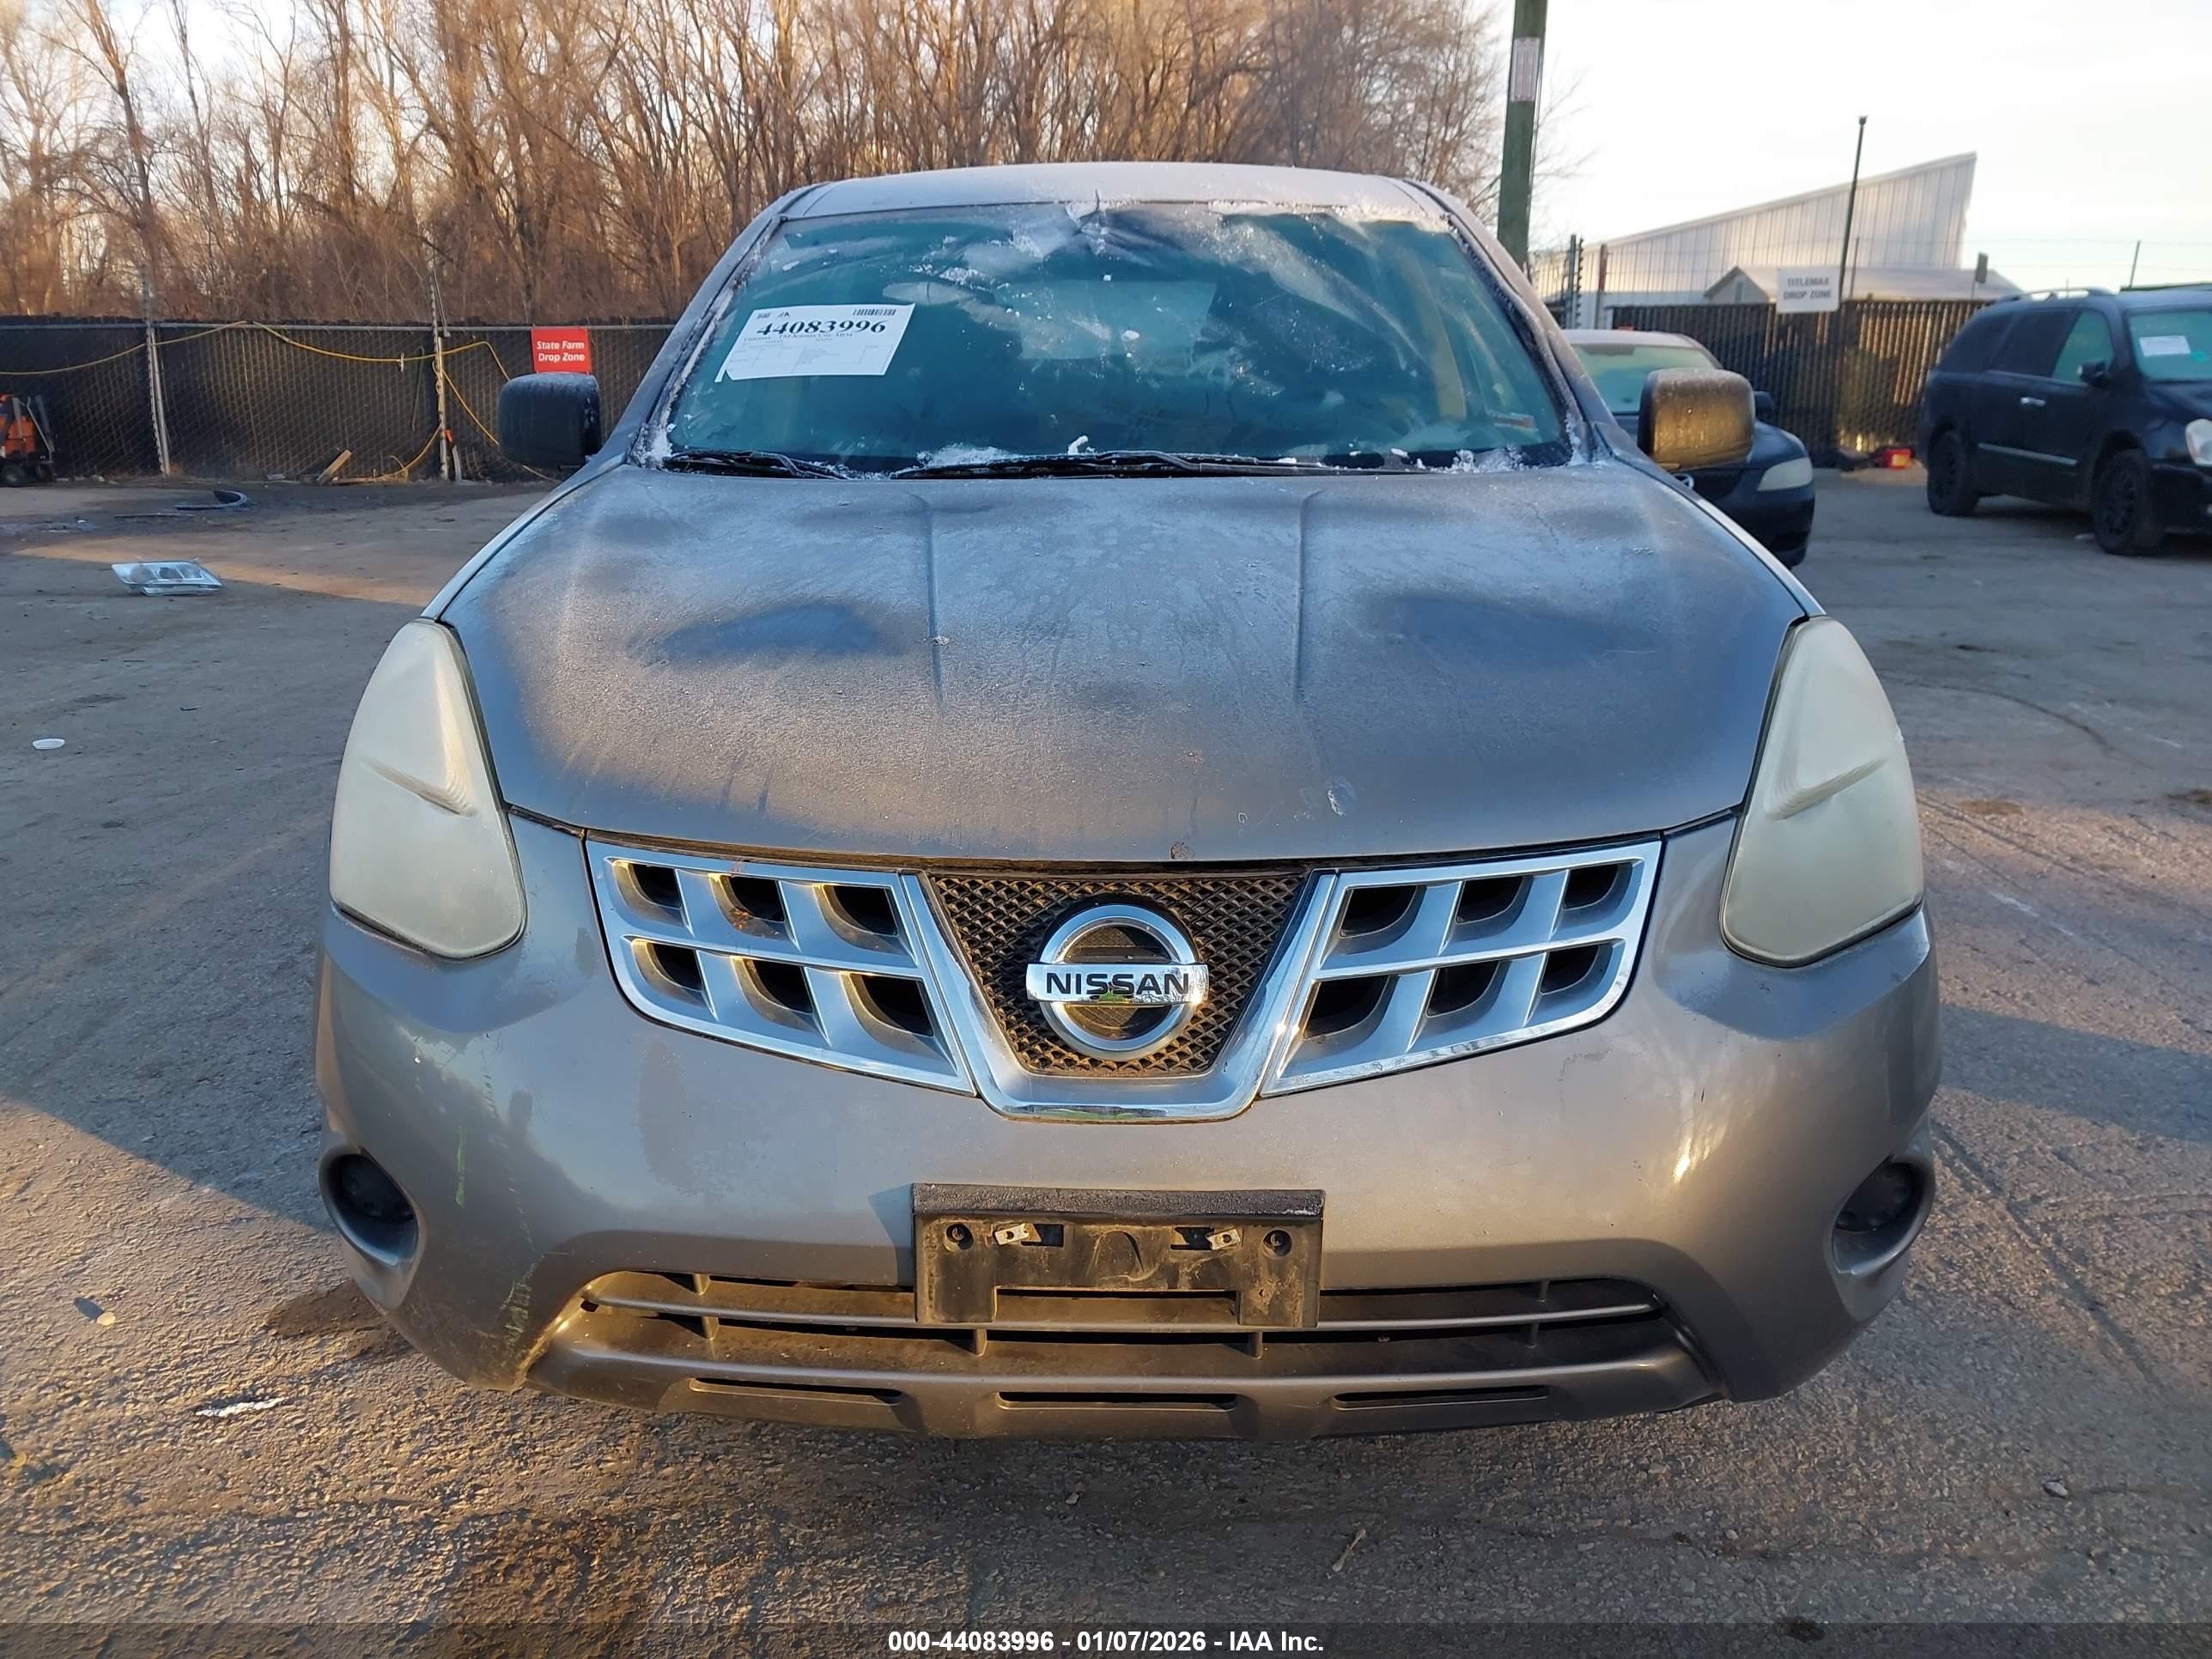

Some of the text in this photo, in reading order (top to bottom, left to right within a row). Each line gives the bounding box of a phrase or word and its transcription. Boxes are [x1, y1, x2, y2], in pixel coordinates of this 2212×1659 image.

[757, 319, 886, 336] 44083996
[536, 340, 585, 350] State Farm
[538, 352, 586, 363] Drop Zone
[1045, 972, 1190, 995] NISSAN
